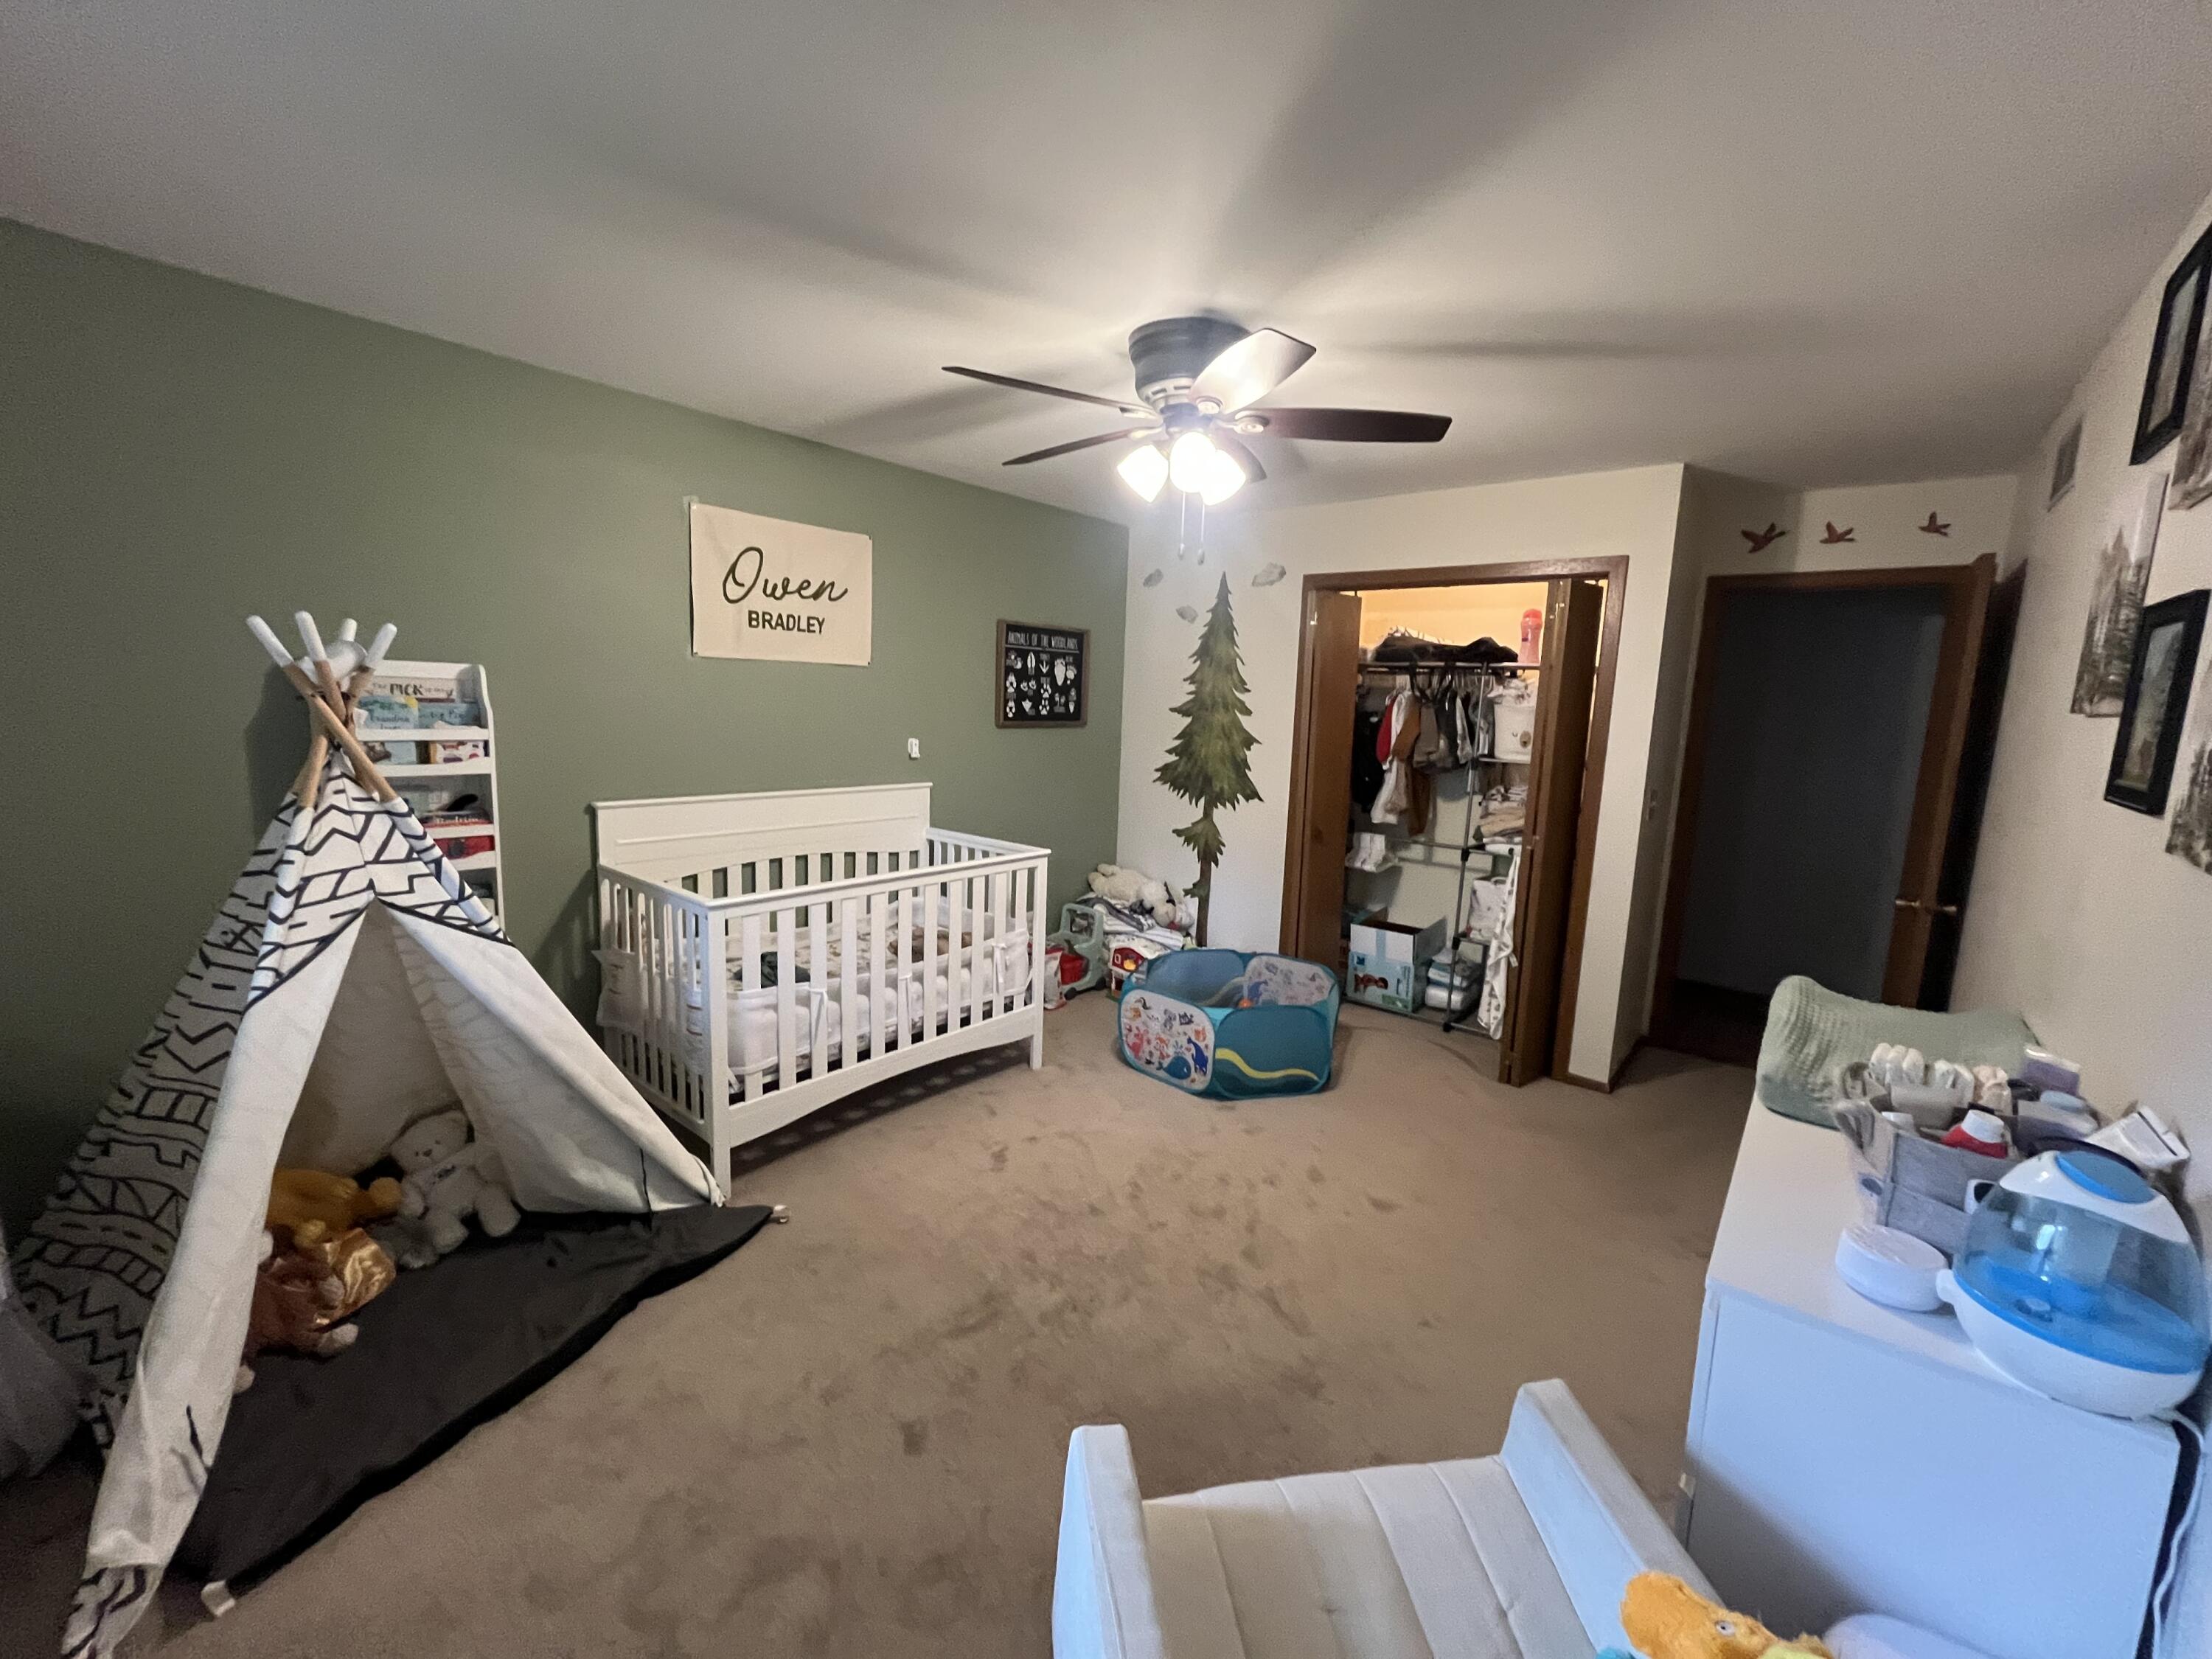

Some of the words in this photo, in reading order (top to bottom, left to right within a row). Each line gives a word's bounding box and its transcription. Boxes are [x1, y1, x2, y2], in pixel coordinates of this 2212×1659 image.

[723, 546, 849, 604] Owen
[748, 610, 825, 634] BRADLEY
[1008, 631, 1029, 645] ANIMALS
[1051, 636, 1078, 650] WOODLANDS
